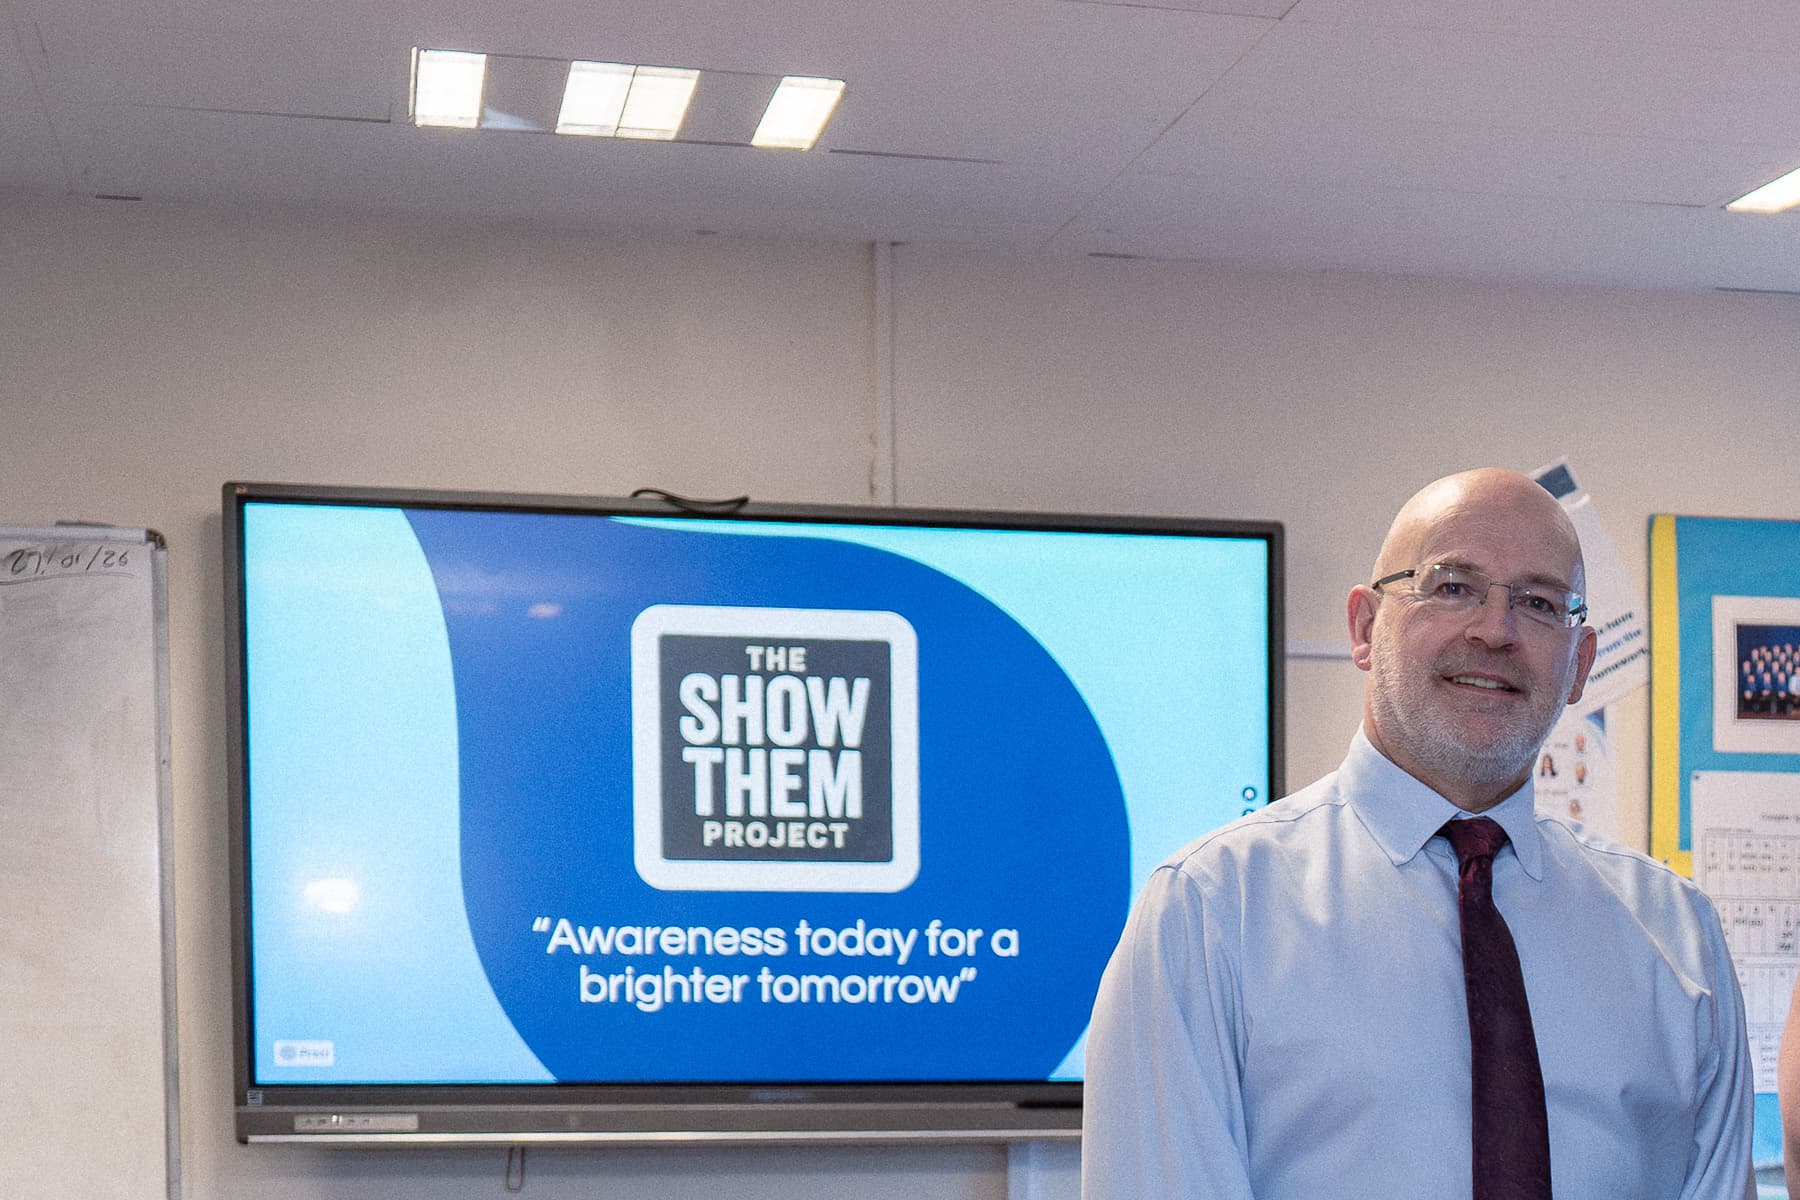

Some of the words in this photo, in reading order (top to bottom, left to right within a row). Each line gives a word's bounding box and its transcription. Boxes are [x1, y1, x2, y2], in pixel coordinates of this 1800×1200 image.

[746, 646, 806, 671] THE
[679, 672, 871, 748] SHOW
[681, 746, 863, 820] THEM
[702, 820, 849, 849] PROJECT
[798, 918, 919, 965] today
[925, 920, 984, 957] for
[990, 926, 1020, 957] a
[579, 964, 750, 1012] brighter
